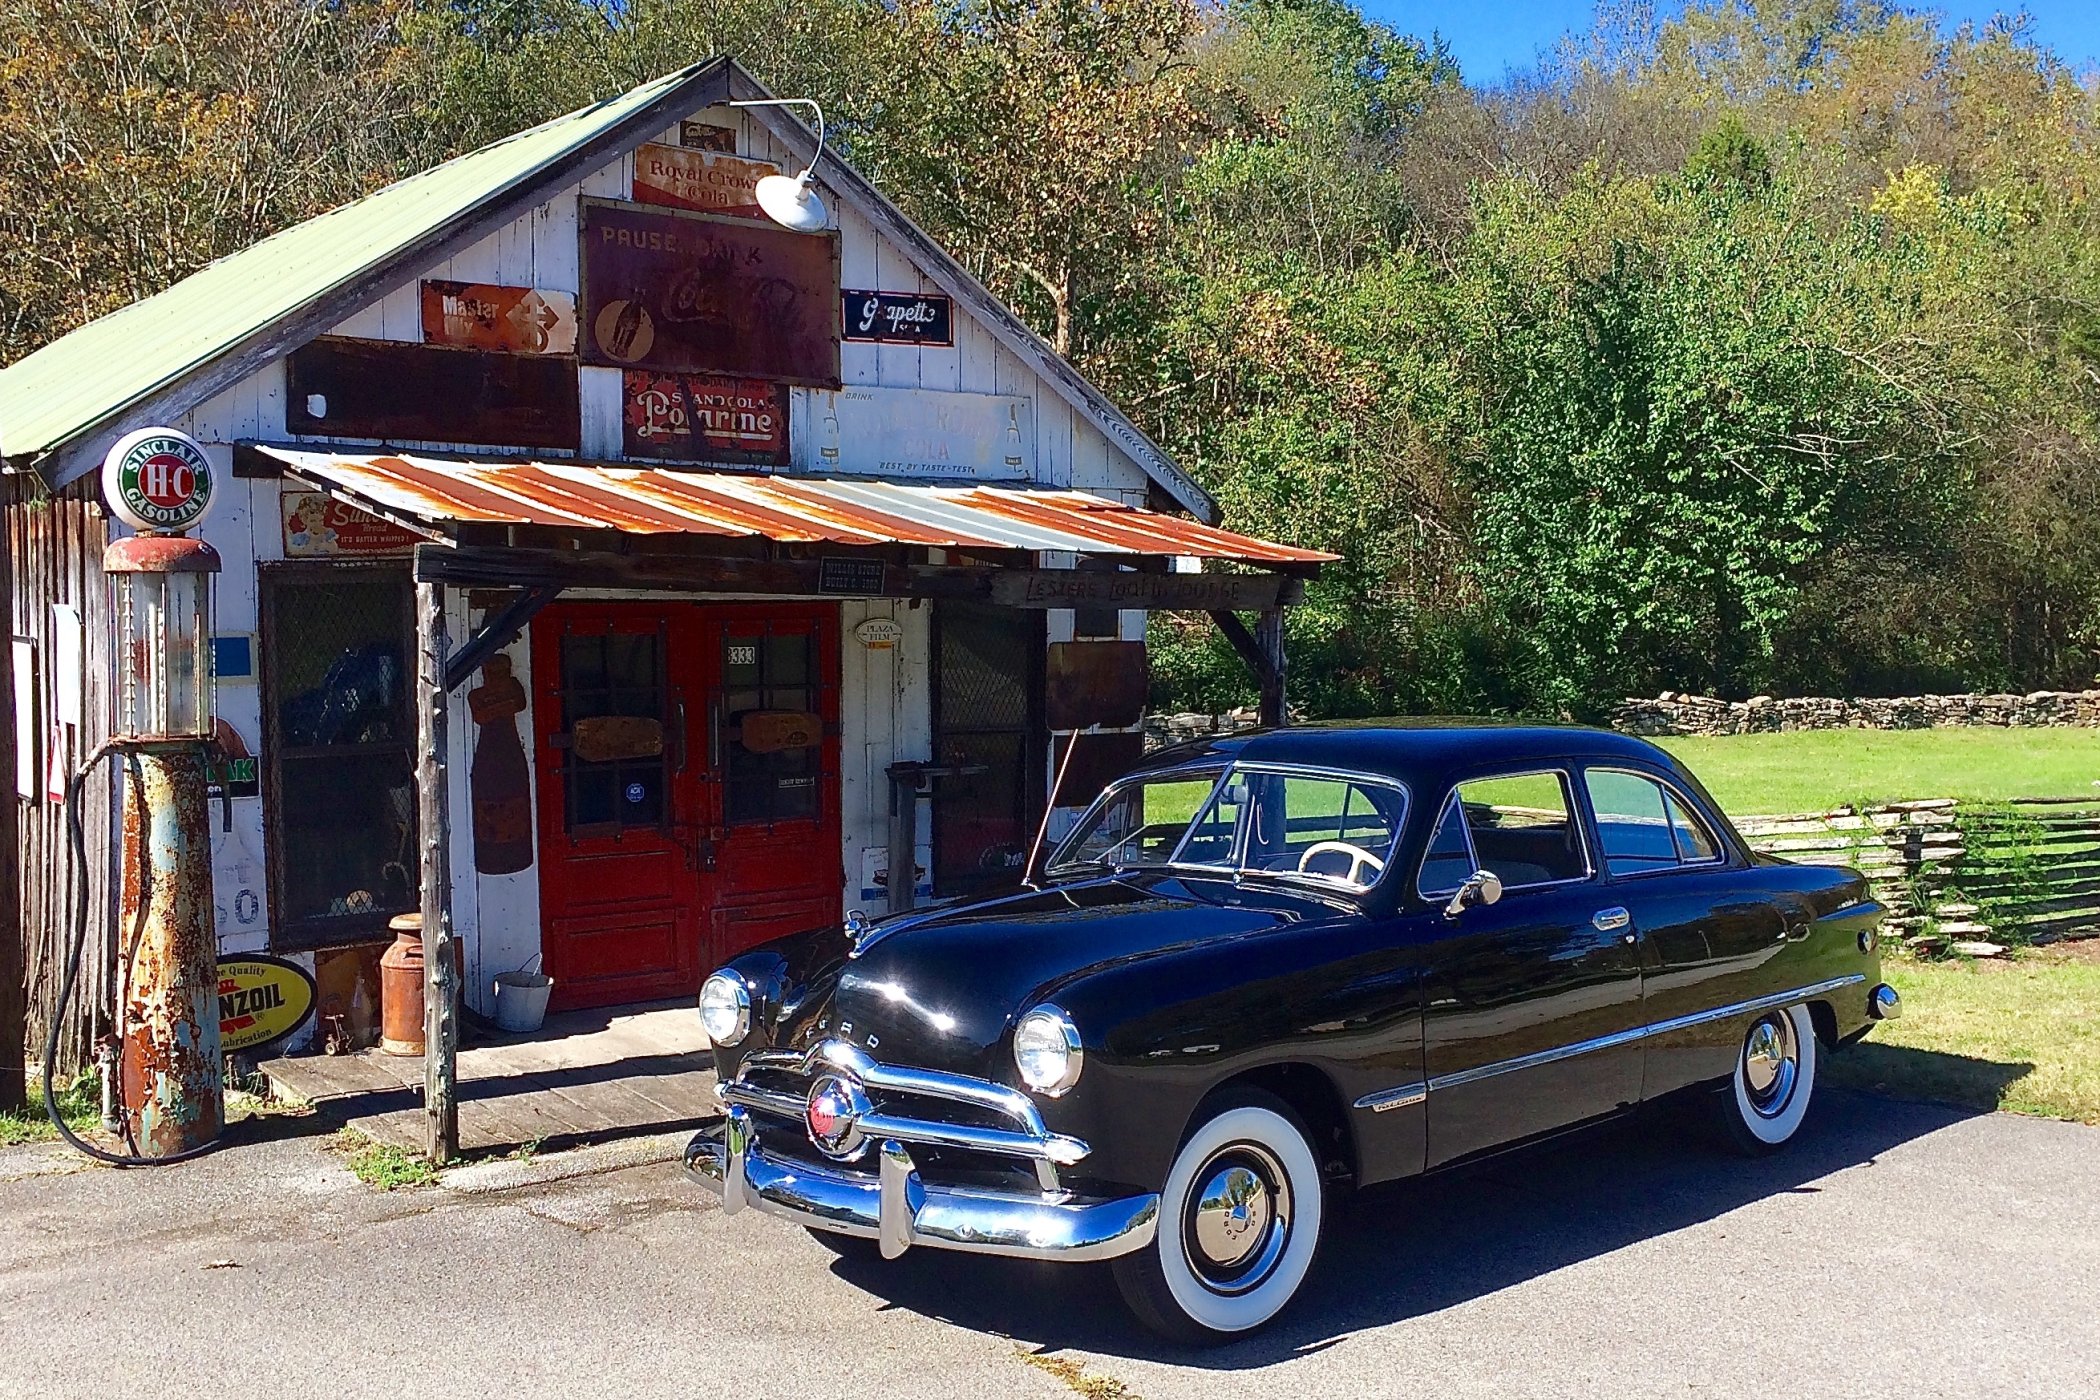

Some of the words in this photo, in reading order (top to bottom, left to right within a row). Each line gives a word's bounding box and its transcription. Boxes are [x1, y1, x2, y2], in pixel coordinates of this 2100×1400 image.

[650, 160, 702, 182] Royal
[687, 185, 728, 204] Cola
[845, 392, 873, 400] DRINK
[637, 390, 773, 438] Poarine
[125, 440, 205, 475] SINCLAIR
[126, 487, 205, 522] GASOLINE
[870, 633, 889, 641] FILM
[229, 965, 267, 977] Quality
[218, 982, 286, 1020] NZOIL
